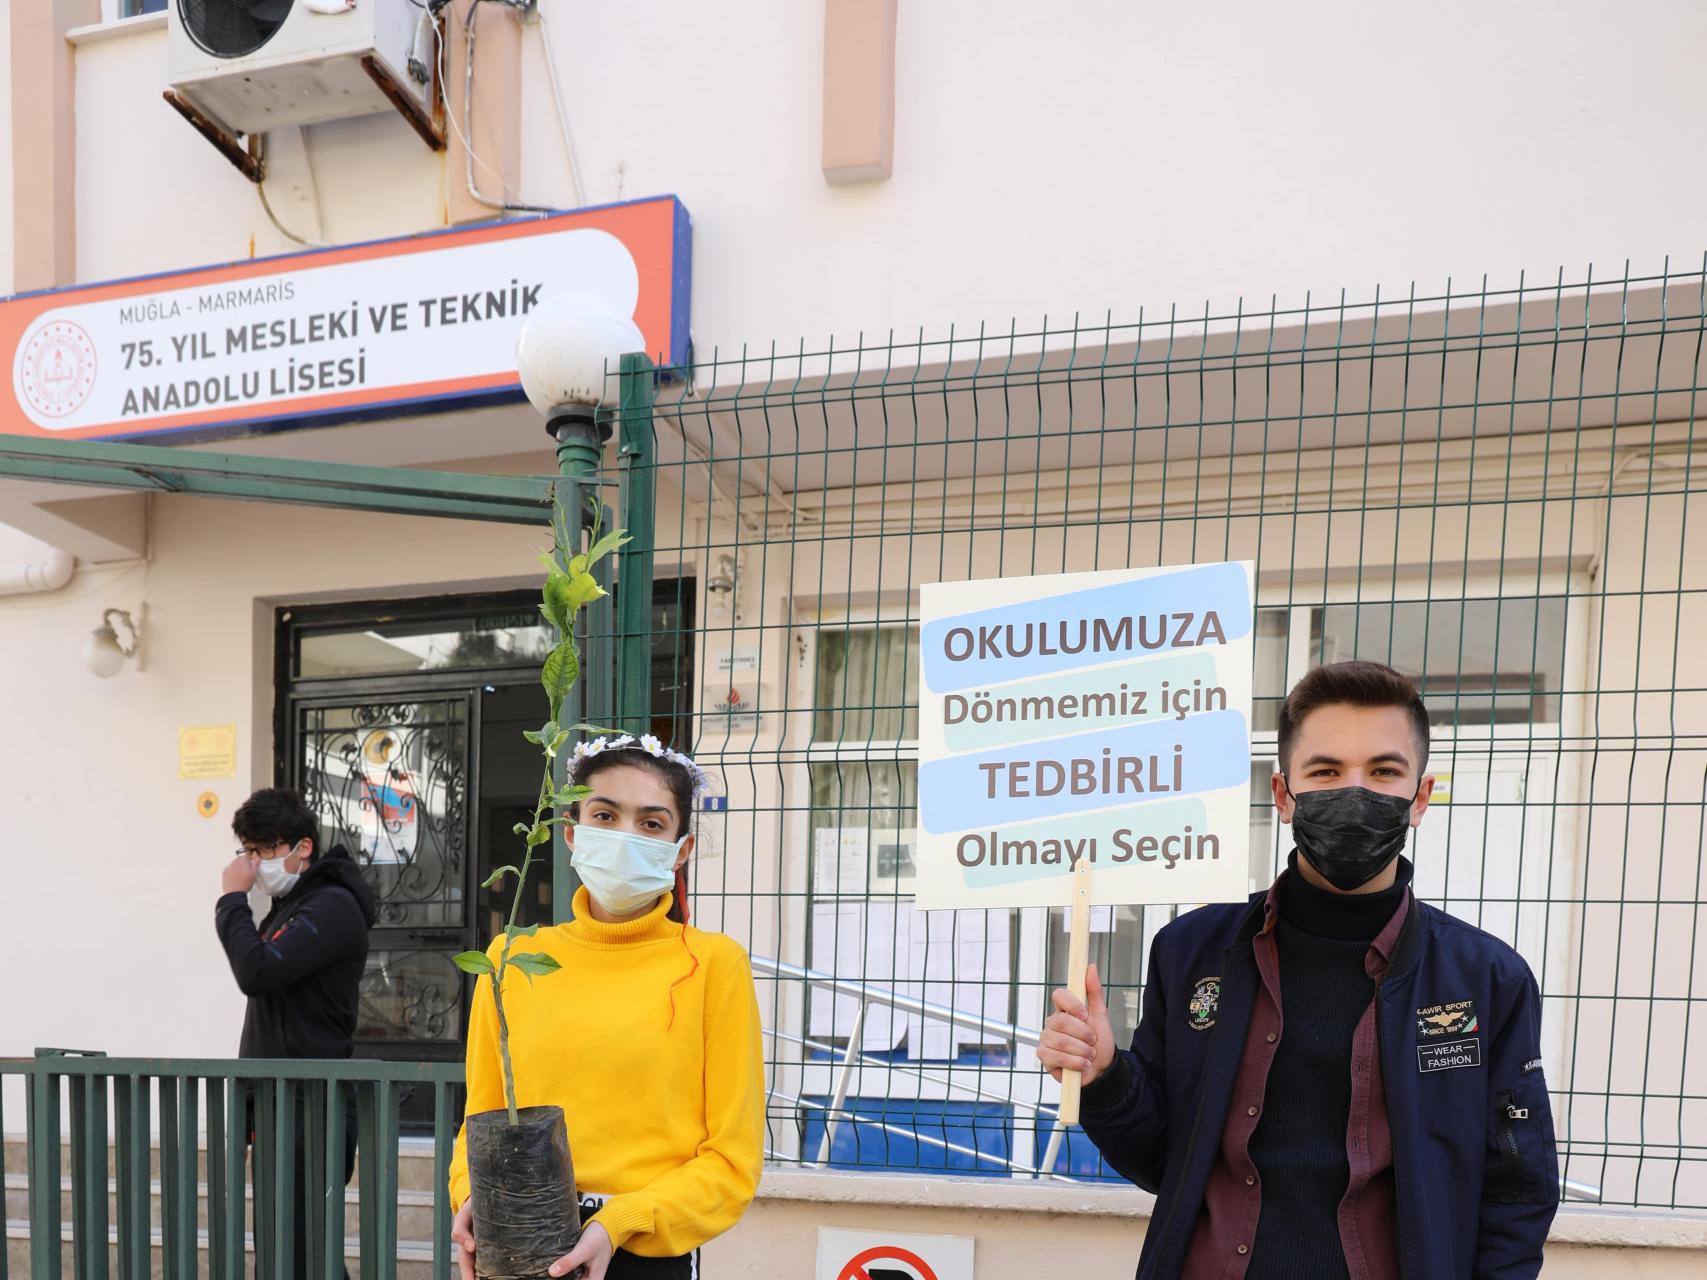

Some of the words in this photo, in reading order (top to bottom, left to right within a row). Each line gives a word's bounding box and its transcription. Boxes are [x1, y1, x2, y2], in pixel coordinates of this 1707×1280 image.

[120, 299, 181, 326] MUĞLA
[199, 279, 295, 314] MARMARİS
[121, 340, 162, 370] 75.
[171, 332, 216, 362] YIL
[226, 301, 358, 355] MESLEKİ
[368, 302, 408, 334] VE
[419, 279, 543, 328] TEKNİK
[121, 371, 260, 416] ANADOLU
[270, 348, 366, 396] LİSESİ
[943, 610, 1227, 662] OKULUMUZA
[943, 683, 1148, 725] Dönmemiz
[1161, 679, 1228, 721] için
[978, 744, 1183, 799] TEDBİRLİ
[711, 797, 719, 810] 8
[956, 831, 1097, 873] Olmayı
[1111, 825, 1220, 870] Seçin
[1445, 1000, 1473, 1011] SPORT
[1427, 1054, 1472, 1069] FASHION
[1433, 1045, 1463, 1056] WEAR
